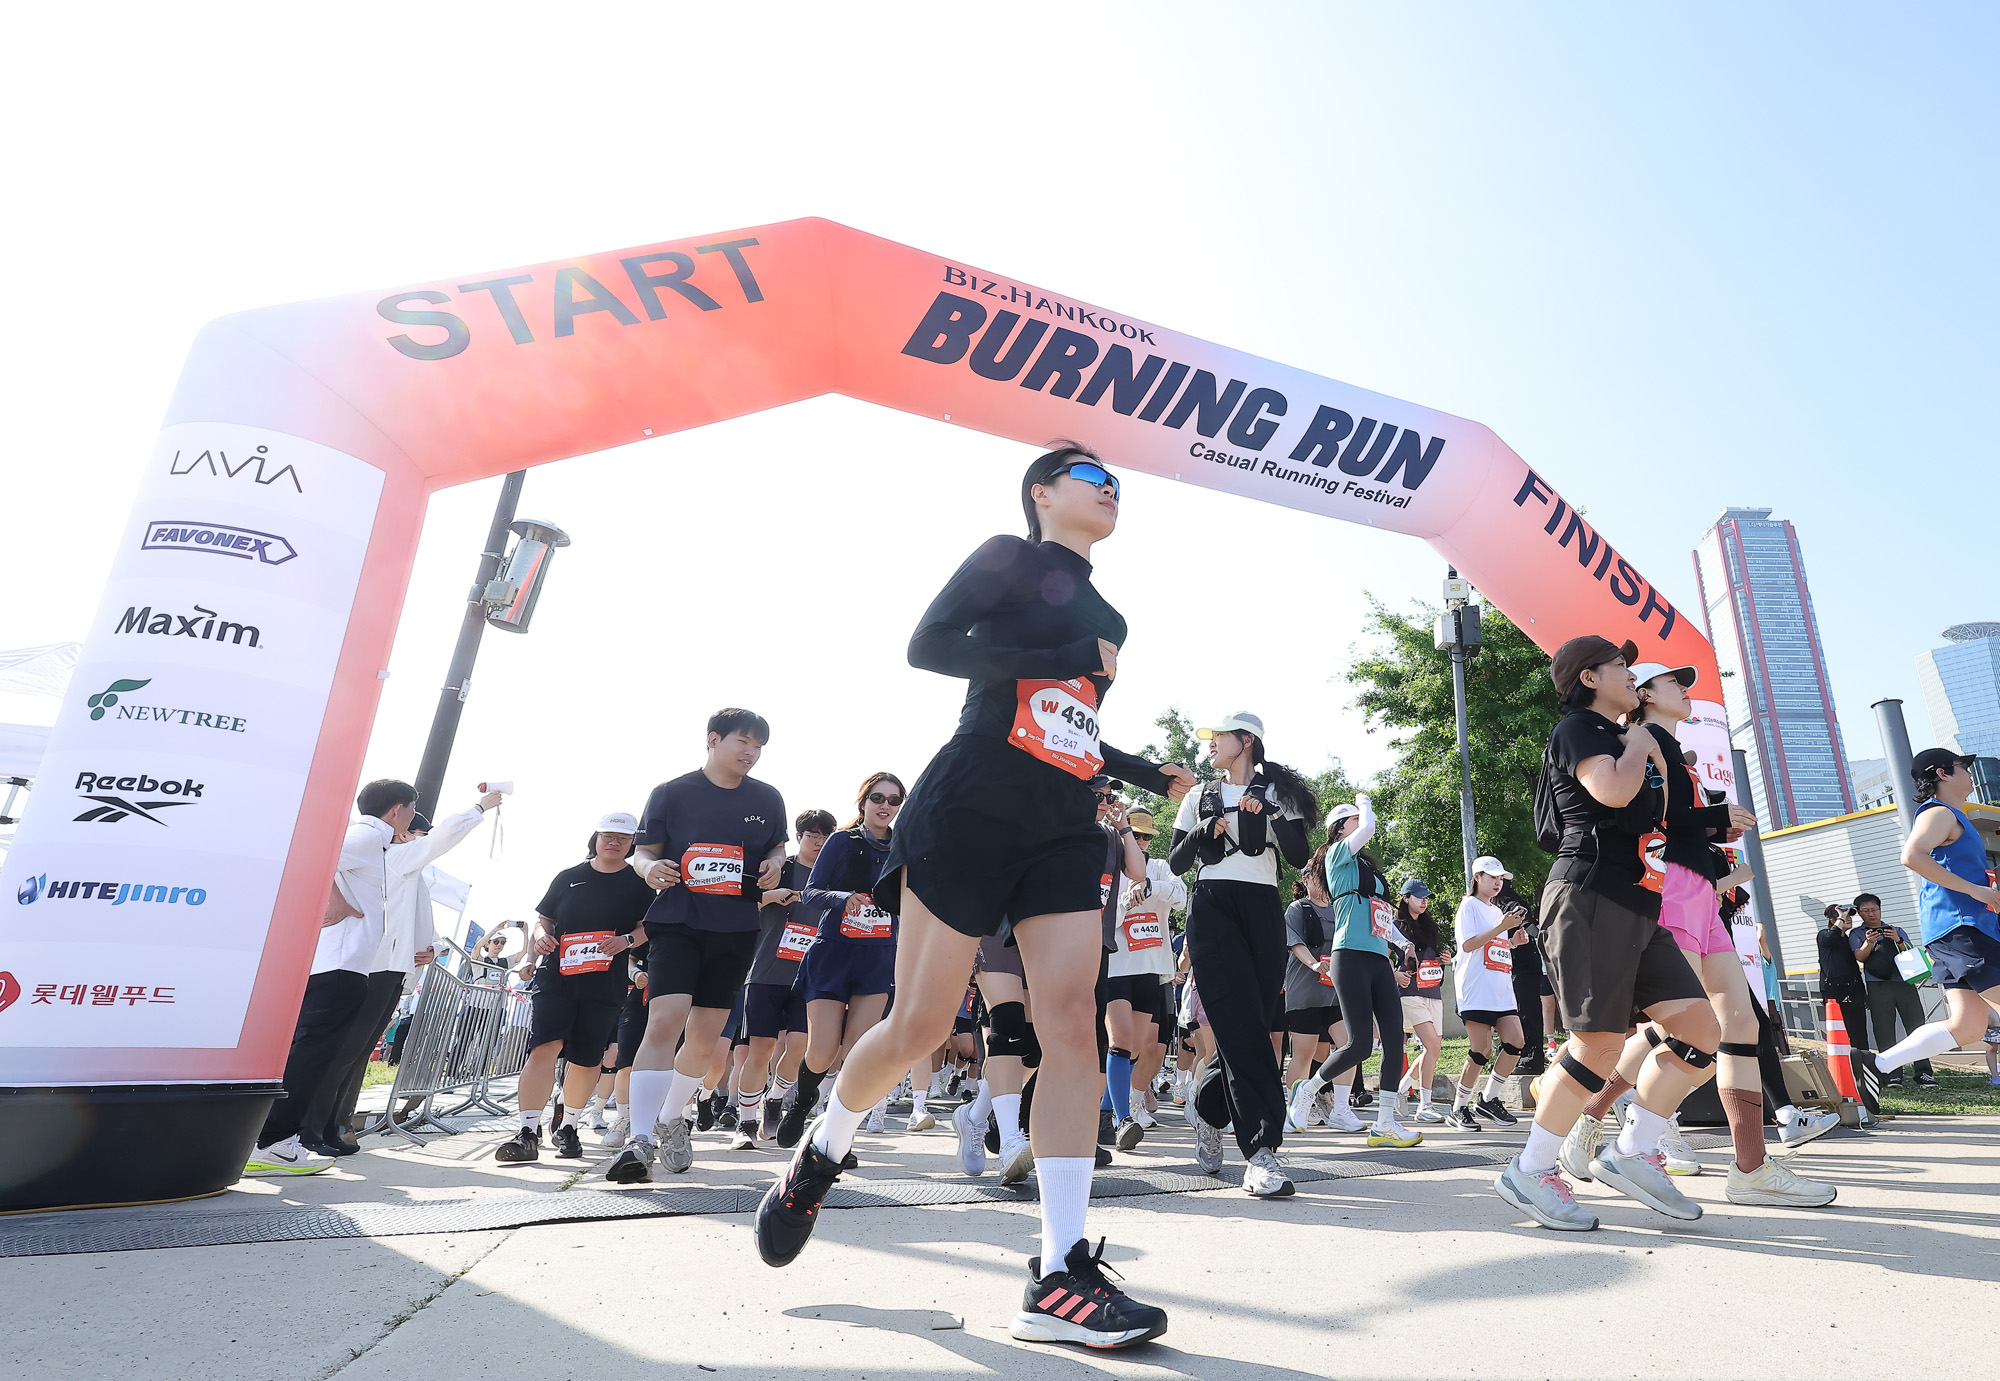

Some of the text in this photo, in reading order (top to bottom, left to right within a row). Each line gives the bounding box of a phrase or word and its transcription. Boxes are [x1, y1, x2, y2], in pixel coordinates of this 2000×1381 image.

[376, 237, 764, 361] START
[901, 291, 1446, 490] BURNING RUN
[1189, 441, 1412, 510] Casual Running Festival
[151, 528, 273, 563] FAVONEX
[1513, 469, 1676, 641] FINISH
[114, 604, 261, 649] Maxim
[116, 704, 247, 733] NEWTREE
[1041, 699, 1100, 743] W 4307
[1051, 734, 1079, 751] C-247
[75, 771, 205, 798] Reebok
[694, 861, 742, 875] M 2796
[1140, 925, 1159, 933] 4430
[569, 949, 578, 957] W
[31, 984, 175, 1006] 롯데웰푸드
